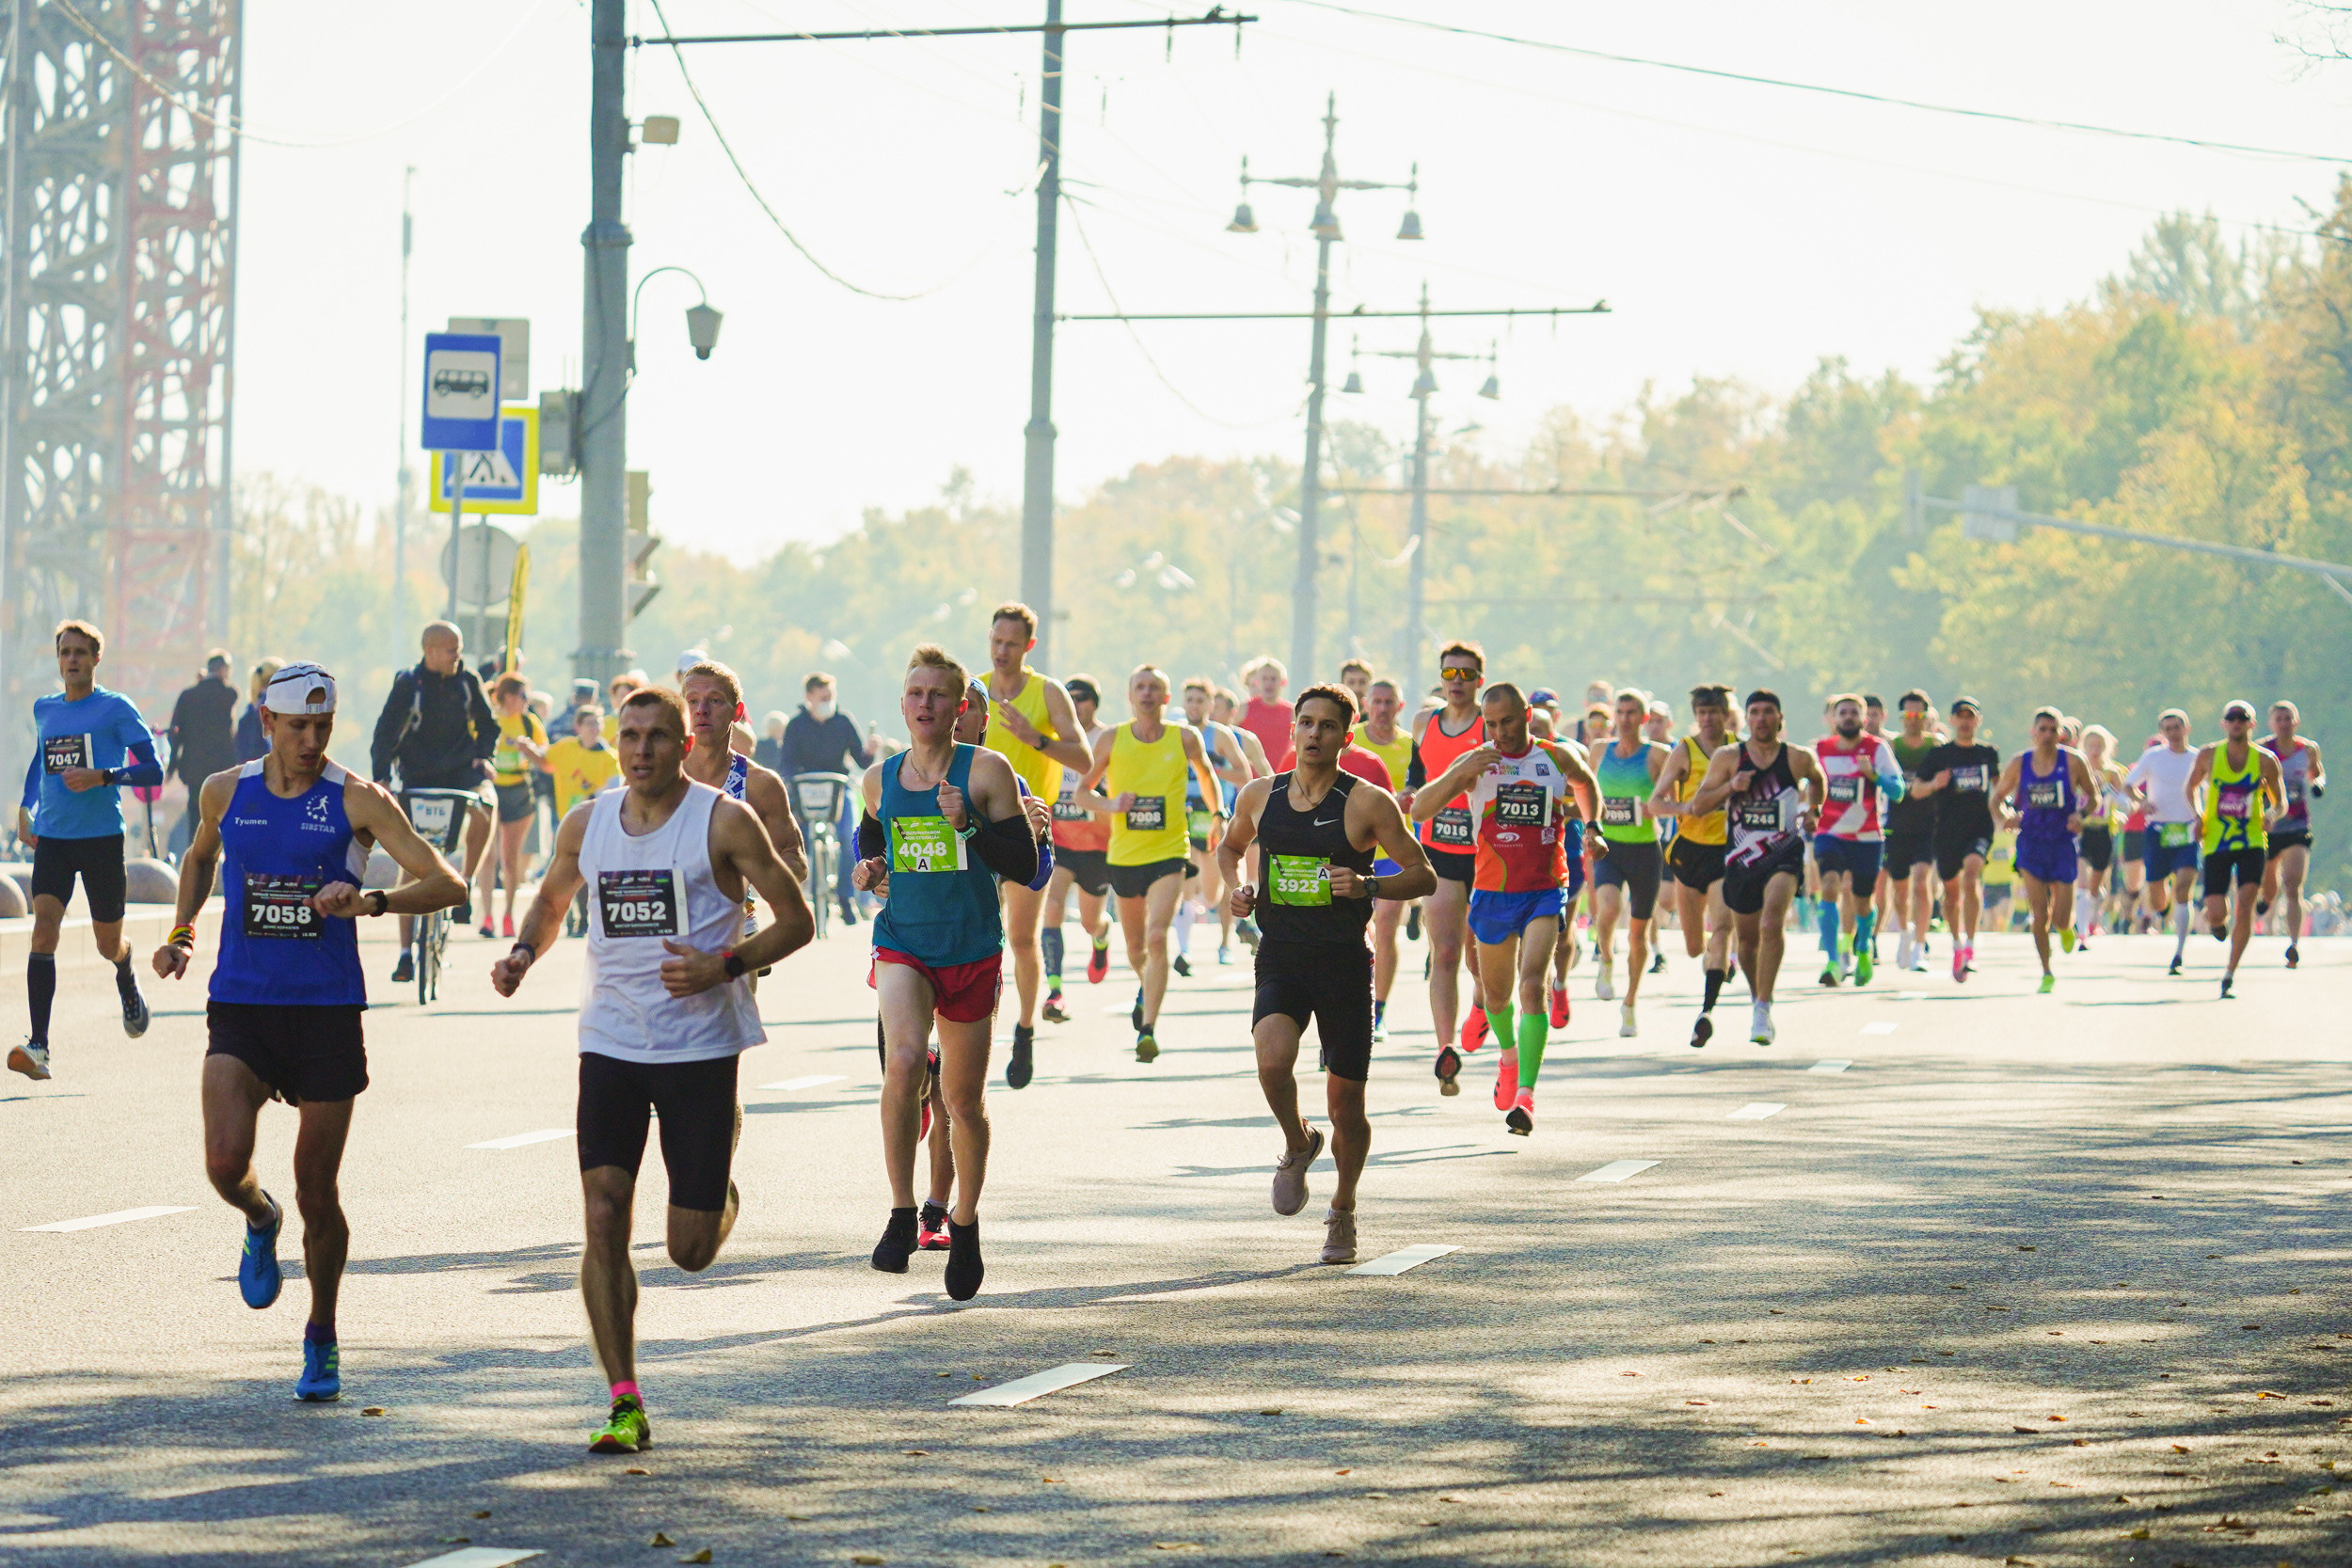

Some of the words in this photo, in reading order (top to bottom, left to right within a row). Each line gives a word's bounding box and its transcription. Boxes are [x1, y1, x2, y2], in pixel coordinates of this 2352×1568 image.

[48, 752, 80, 767] 7047
[1502, 802, 1539, 816] 7013
[234, 816, 268, 827] Tyumen
[1129, 811, 1162, 823] 7008
[1743, 813, 1775, 825] 7248
[301, 822, 336, 833] SIBSTAR
[1436, 822, 1469, 837] 7016
[898, 841, 947, 857] 4048
[918, 859, 929, 871] A
[1318, 867, 1328, 879] A
[1278, 879, 1320, 894] 3923
[251, 904, 311, 924] 7058
[607, 901, 667, 923] 7052
